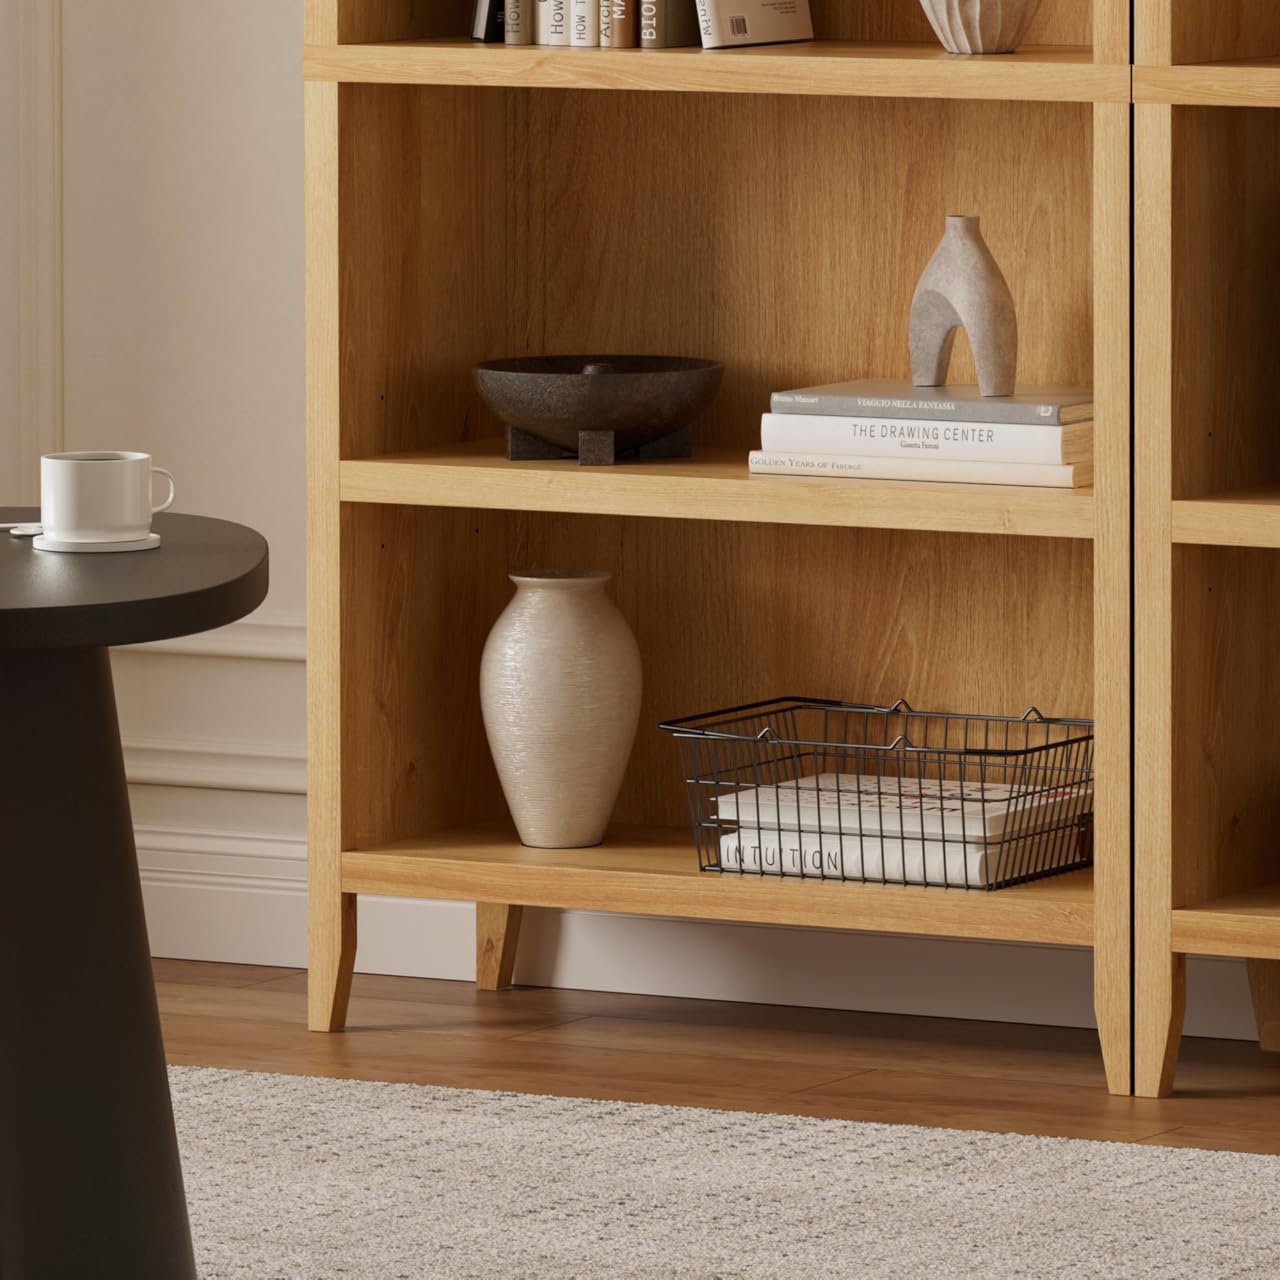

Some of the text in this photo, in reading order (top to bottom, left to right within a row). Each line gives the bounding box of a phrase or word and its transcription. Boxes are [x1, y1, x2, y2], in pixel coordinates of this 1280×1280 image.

[507, 0, 520, 33] How
[551, 0, 564, 34] How
[576, 15, 586, 40] HOW
[857, 399, 956, 410] VIAGGIO NELLA FANTASIA
[852, 424, 995, 442] THE DRAWING CENTER
[788, 458, 816, 468] YEARS
[726, 844, 838, 871] INTUTION
